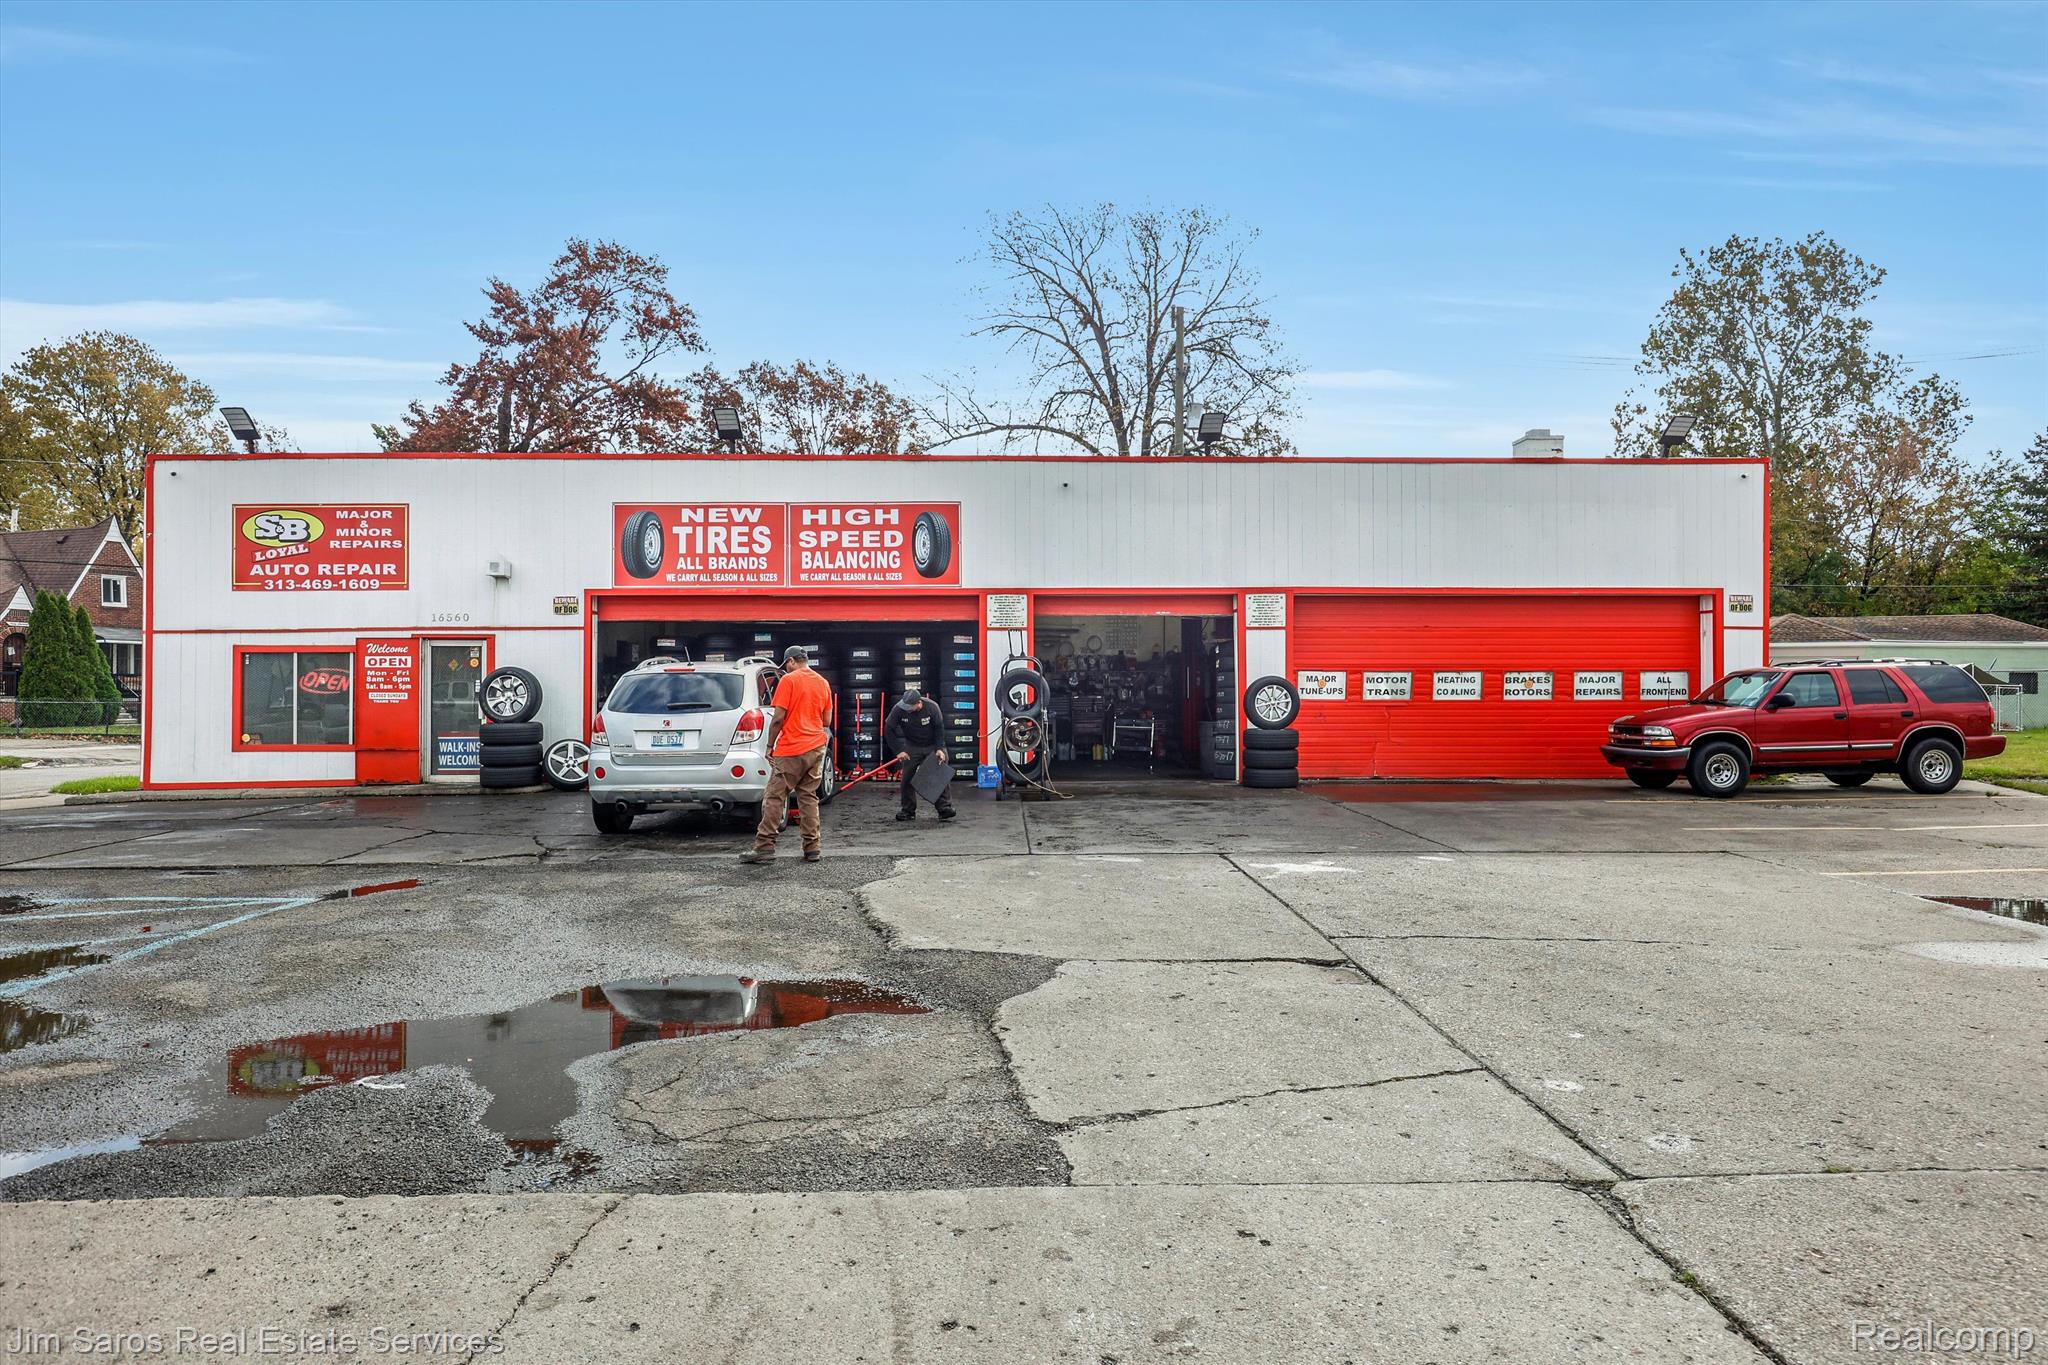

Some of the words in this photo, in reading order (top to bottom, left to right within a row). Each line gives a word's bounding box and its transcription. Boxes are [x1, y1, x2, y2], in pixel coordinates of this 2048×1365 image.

[336, 510, 393, 519] MAJOR
[682, 508, 762, 523] NEW
[803, 509, 899, 525] HIGH
[255, 515, 310, 541] S&B
[360, 520, 368, 528] &
[336, 529, 392, 537] MINOR
[673, 526, 772, 554] TIRES
[799, 531, 904, 548] SPEED
[330, 540, 403, 549] REPAIRS
[255, 544, 309, 561] LOYAL
[677, 557, 704, 570] ALL
[709, 557, 768, 570] BRANDS
[802, 551, 901, 569] BALANCING
[250, 564, 310, 576] AUTO
[318, 564, 397, 575] REPAIR
[666, 573, 676, 582] WE
[677, 573, 699, 582] CARRY
[700, 573, 711, 582] ALL
[713, 573, 738, 582] SEASON
[740, 573, 744, 582] &
[747, 573, 758, 582] ALL
[760, 573, 778, 582] SIZES
[800, 573, 809, 581] WE
[810, 573, 829, 581] CARRY
[831, 573, 841, 581] ALL
[843, 573, 865, 581] SEASON
[874, 573, 884, 581] ALL
[886, 573, 902, 581] SIZES
[264, 580, 380, 590] 313-469-1609
[432, 614, 469, 622] 16560
[366, 643, 409, 654] Welcome
[368, 658, 408, 666] OPEN
[304, 671, 349, 692] OPEN
[1505, 676, 1551, 684] BRAKES
[1656, 676, 1672, 684] ALL
[1368, 688, 1406, 696] TRANS
[1505, 688, 1550, 696] ROTORS
[1576, 688, 1619, 696] REPAIRS
[439, 742, 480, 752] WALK-INS
